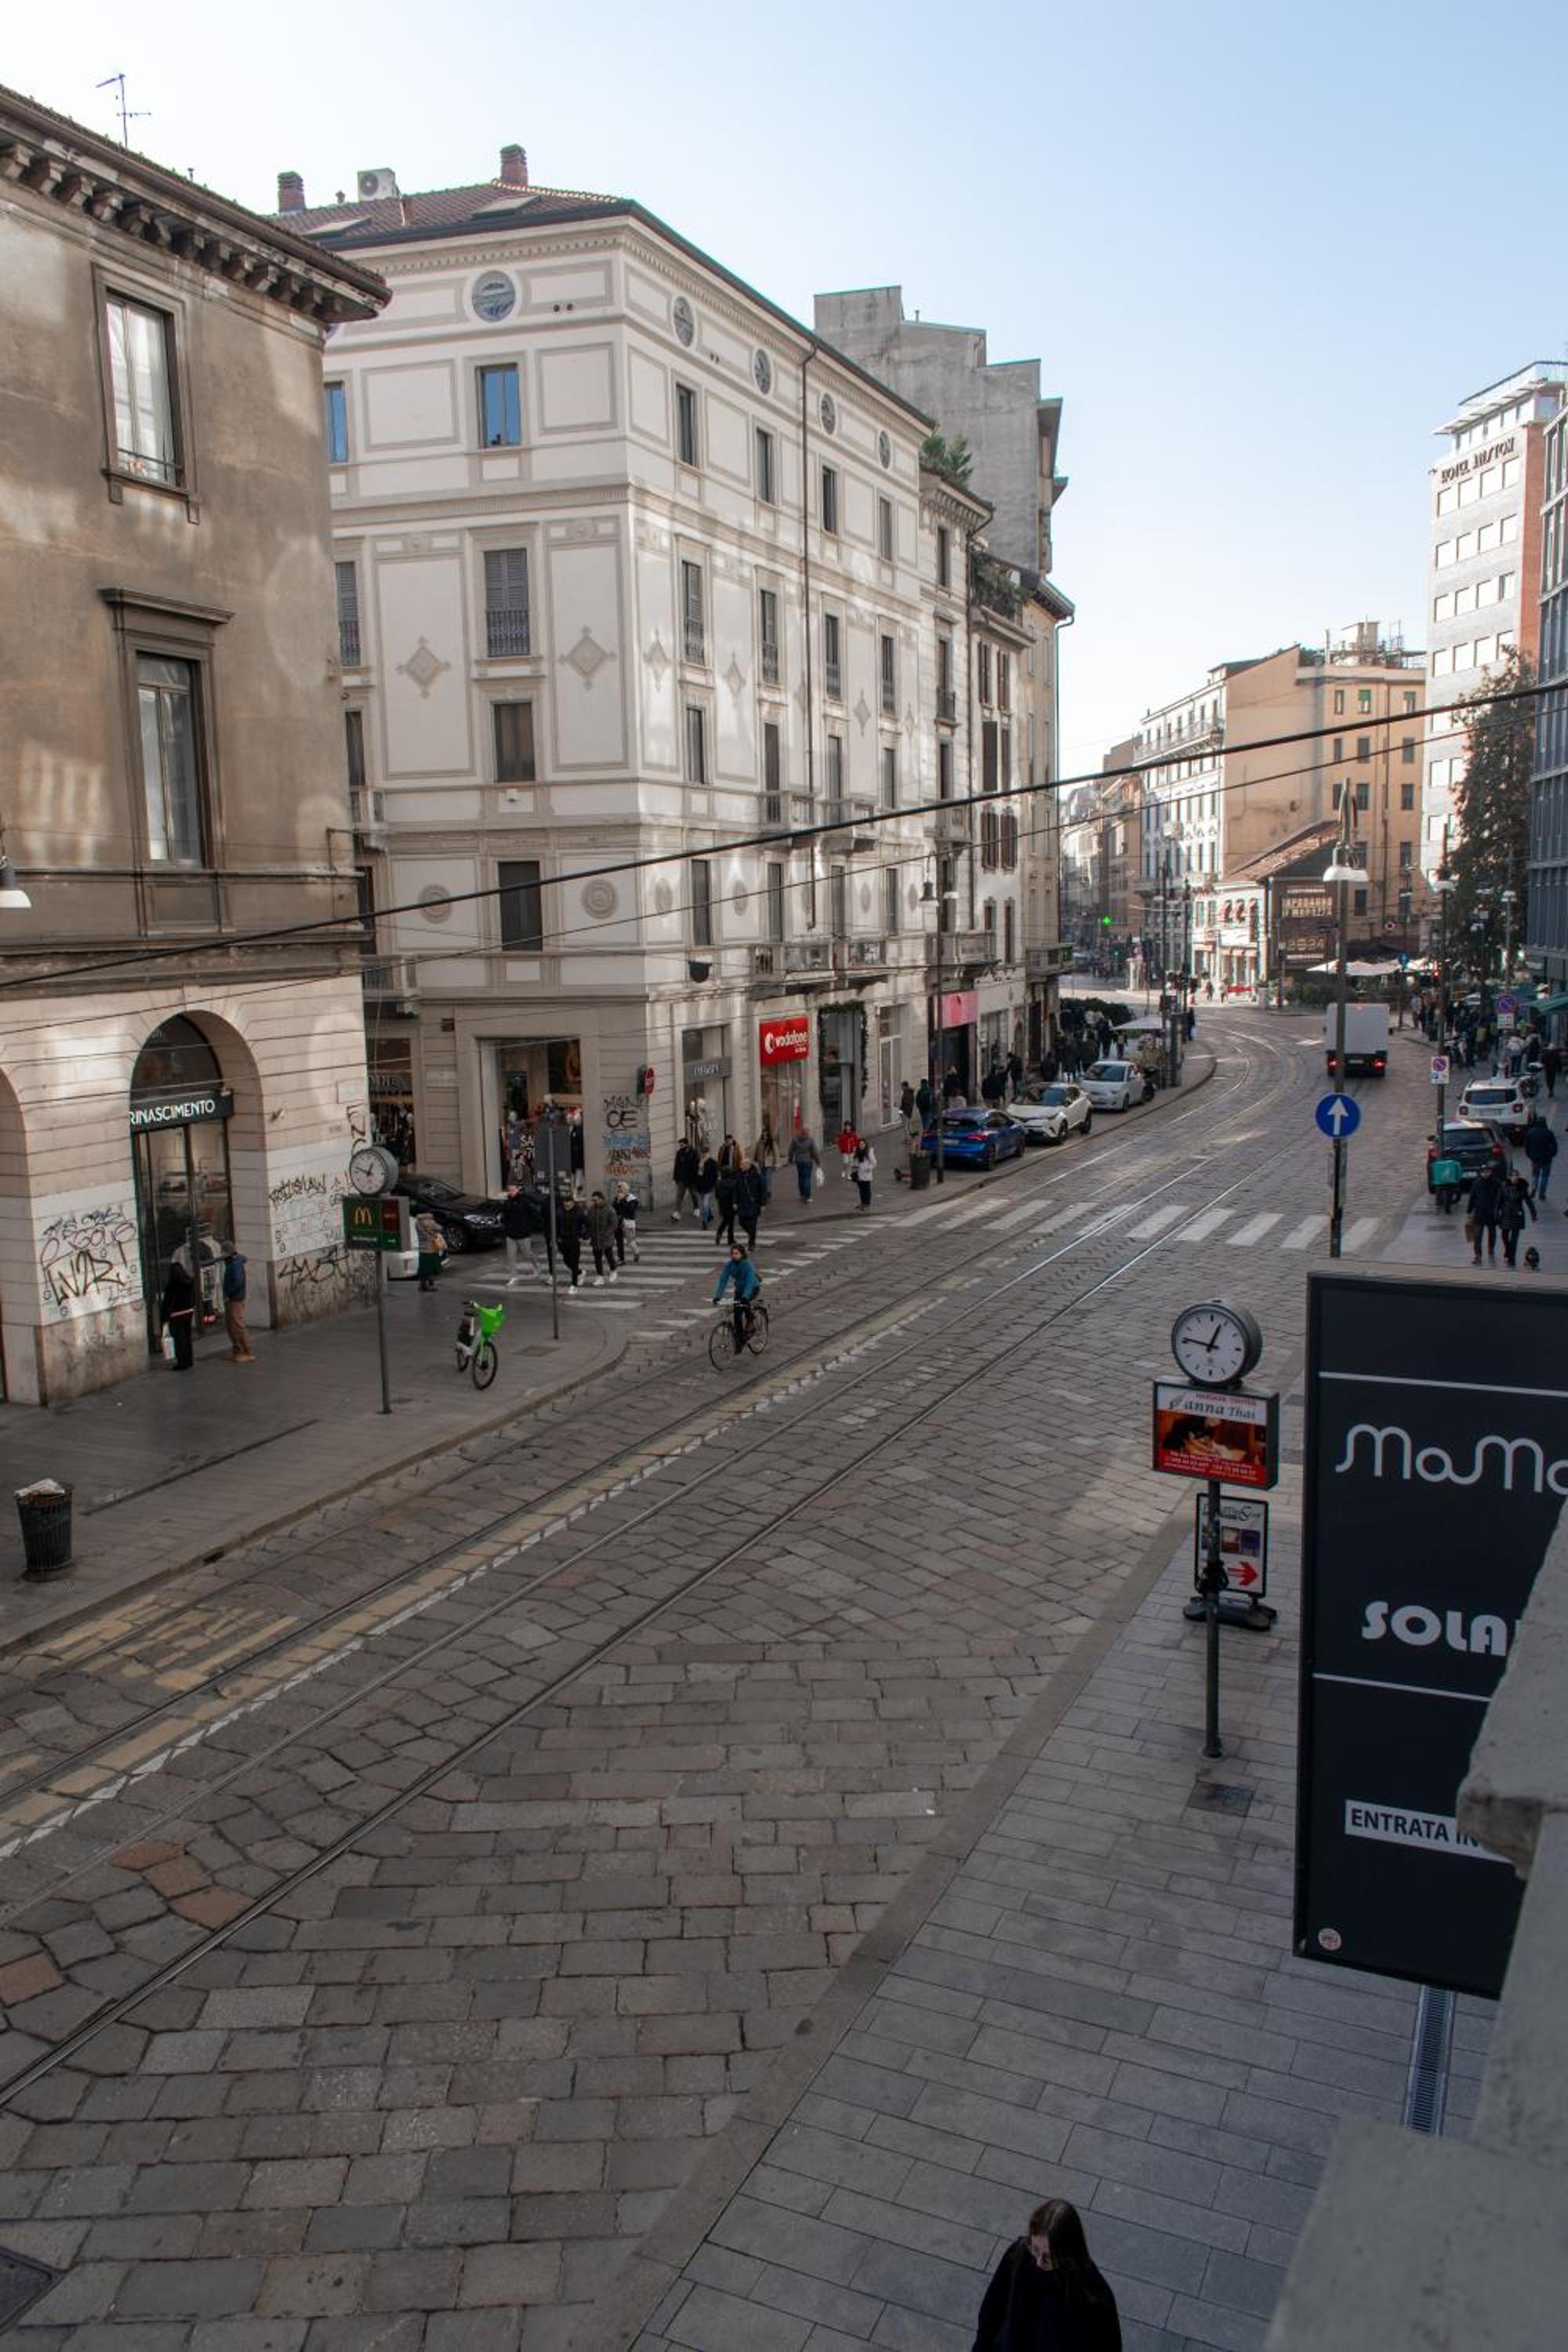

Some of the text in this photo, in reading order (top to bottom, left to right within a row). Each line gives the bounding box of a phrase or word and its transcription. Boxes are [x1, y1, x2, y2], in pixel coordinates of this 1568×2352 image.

[775, 1029, 808, 1047] vodafone
[129, 1099, 216, 1125] RINASCIMENTO
[1361, 1601, 1521, 1657] SOLA
[1351, 1808, 1449, 1842] ENTRATA
